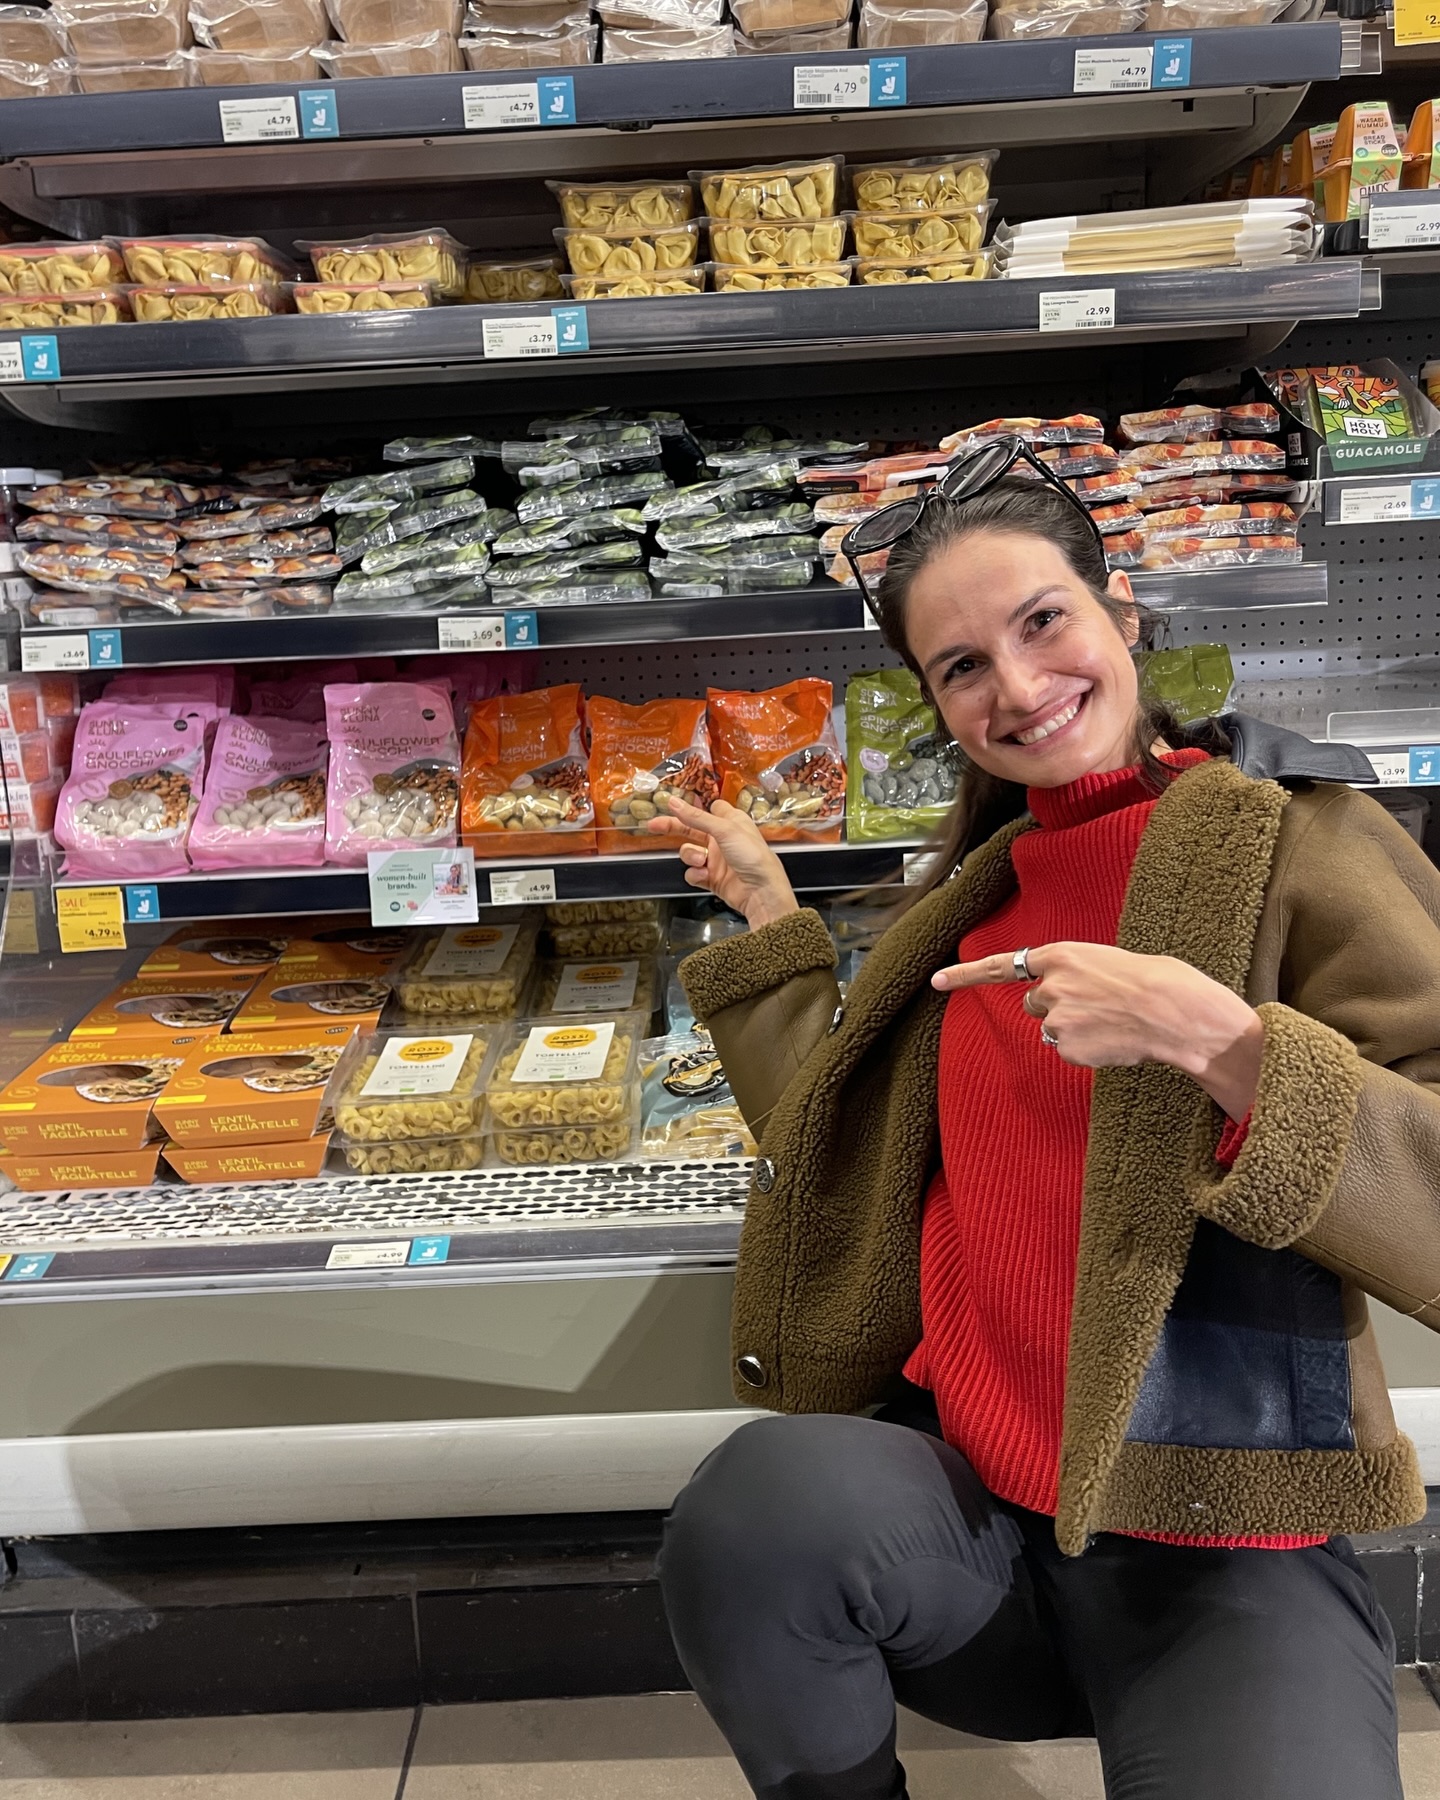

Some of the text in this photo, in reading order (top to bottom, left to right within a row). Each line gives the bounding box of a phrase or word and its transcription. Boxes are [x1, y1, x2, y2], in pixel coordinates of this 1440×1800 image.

[1121, 67, 1146, 76] £4.79
[833, 82, 857, 93] 4.79
[510, 102, 534, 111] £4.79
[267, 116, 291, 125] £4.79
[1416, 222, 1440, 231] £2.99
[1086, 307, 1110, 315] £2.99
[529, 334, 552, 343] £3.79
[1349, 421, 1380, 429] HOLY
[1351, 427, 1381, 435] MOLY
[1335, 444, 1422, 459] GUACAMOLE
[1384, 501, 1406, 510] £2.69
[472, 630, 492, 640] 3.69
[344, 737, 440, 747] CAULIFLOWER
[86, 747, 185, 761] CAULIFLOWER
[605, 743, 670, 755] GNOCCHI
[86, 760, 154, 770] GNOCCHI
[1383, 768, 1405, 776] £3.99
[376, 872, 427, 881] women-built
[387, 882, 417, 890] brands.
[530, 884, 551, 892] £4.99
[210, 1114, 256, 1125] LENTIL
[38, 1122, 85, 1132] LENTIL
[212, 1118, 299, 1133] TAGLIATELLE
[41, 1128, 129, 1140] TAGLIATELLE
[218, 1157, 263, 1167] LENTIL
[49, 1165, 96, 1175] LENTIL
[220, 1161, 306, 1174] TAGLIATELLE
[52, 1170, 138, 1182] TAGLIATELLE
